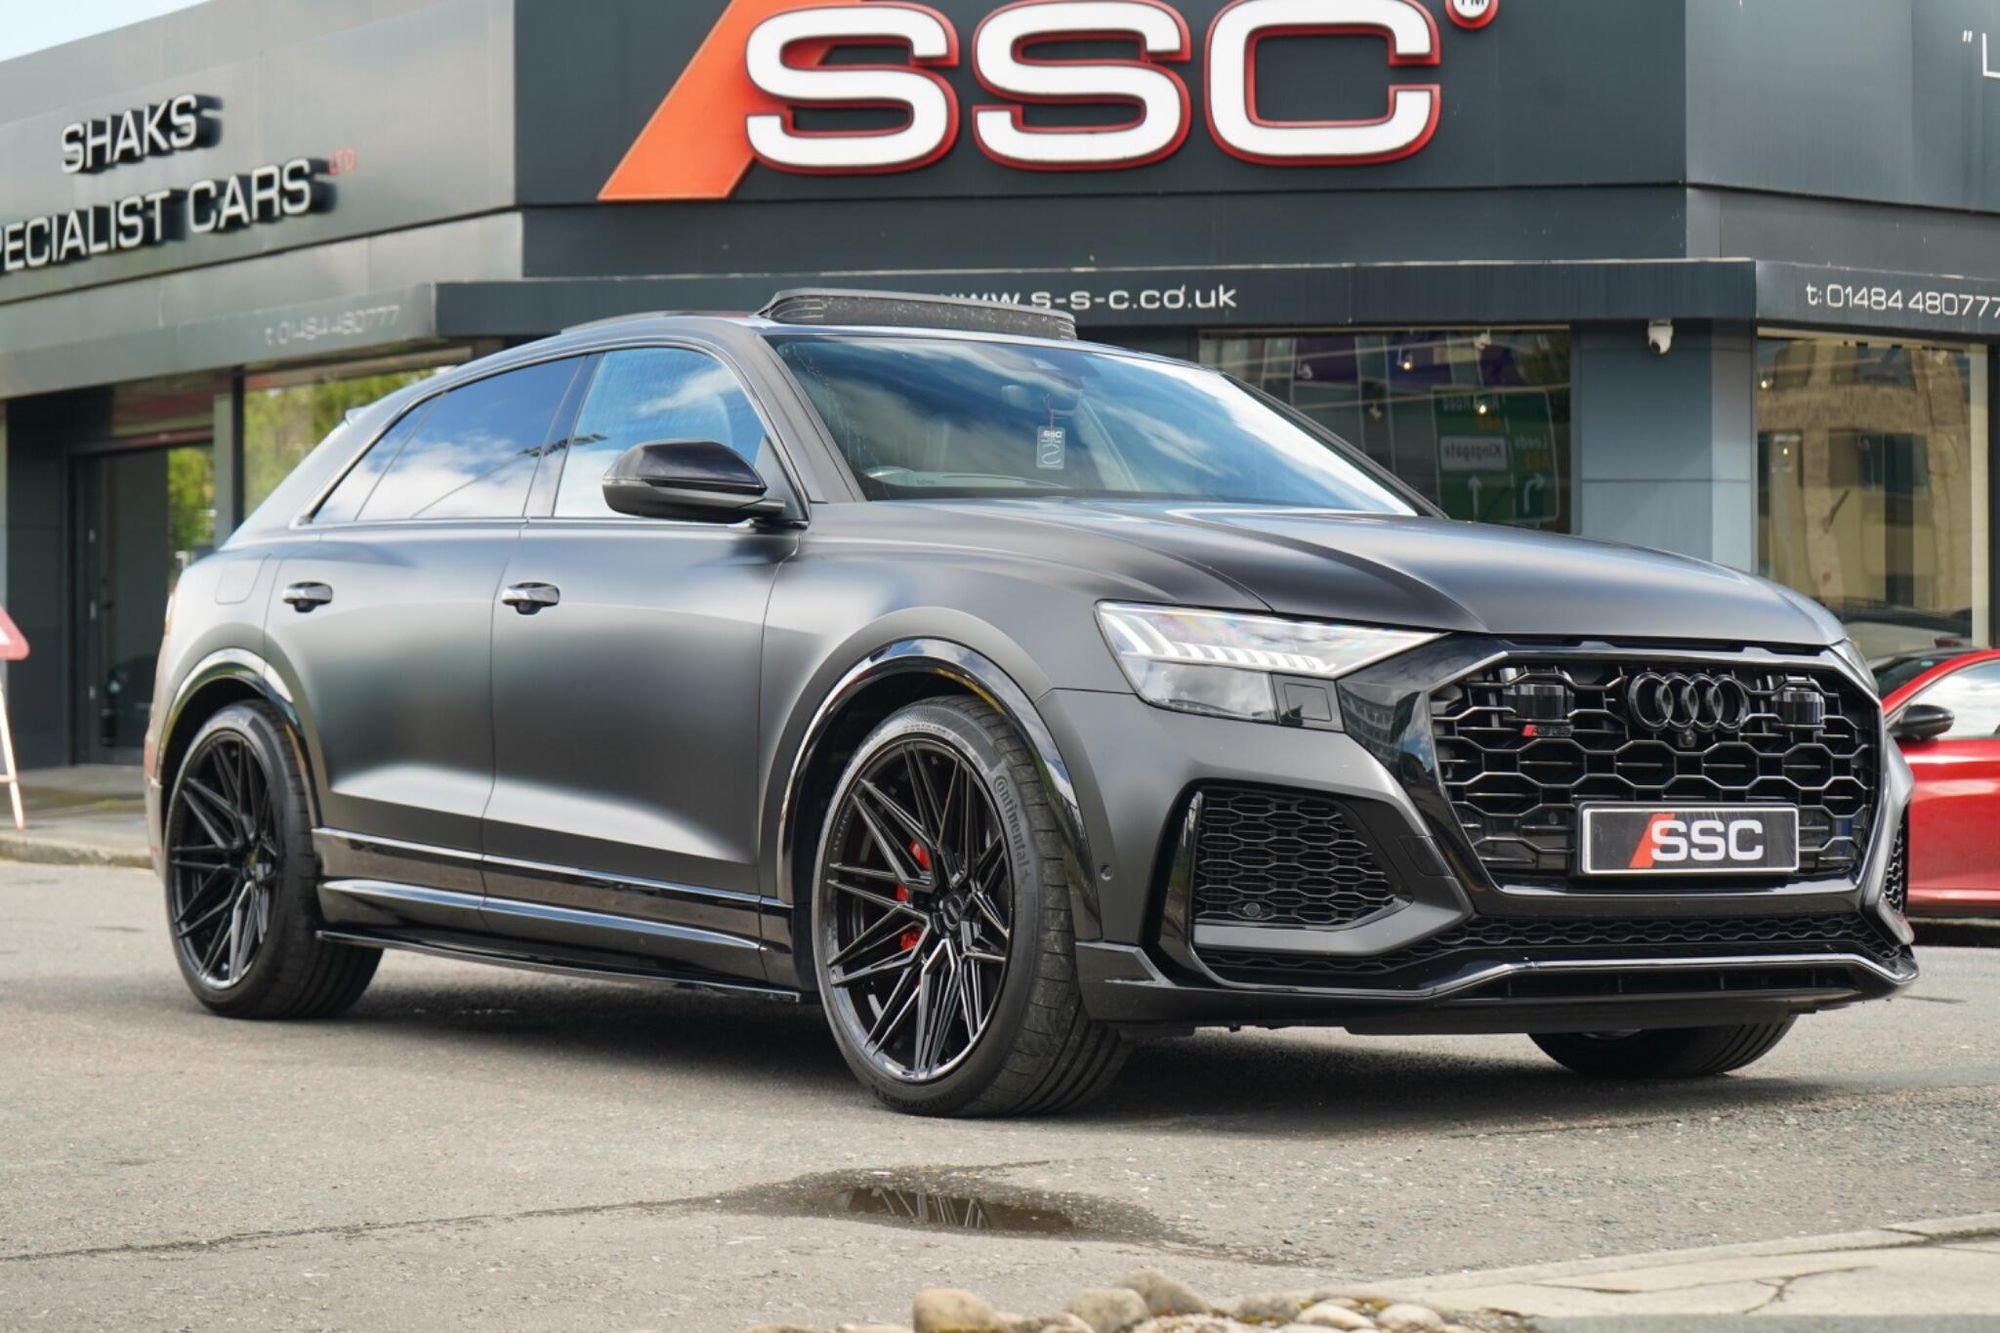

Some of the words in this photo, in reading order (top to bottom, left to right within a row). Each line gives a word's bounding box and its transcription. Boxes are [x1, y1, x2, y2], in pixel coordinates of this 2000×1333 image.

[746, 0, 1440, 173] SSC
[61, 94, 197, 174] SHAKS
[0, 191, 170, 272] ECIALIST
[188, 158, 312, 234] CARS
[993, 775, 1031, 867] Continental
[1650, 819, 1763, 861] SSC
